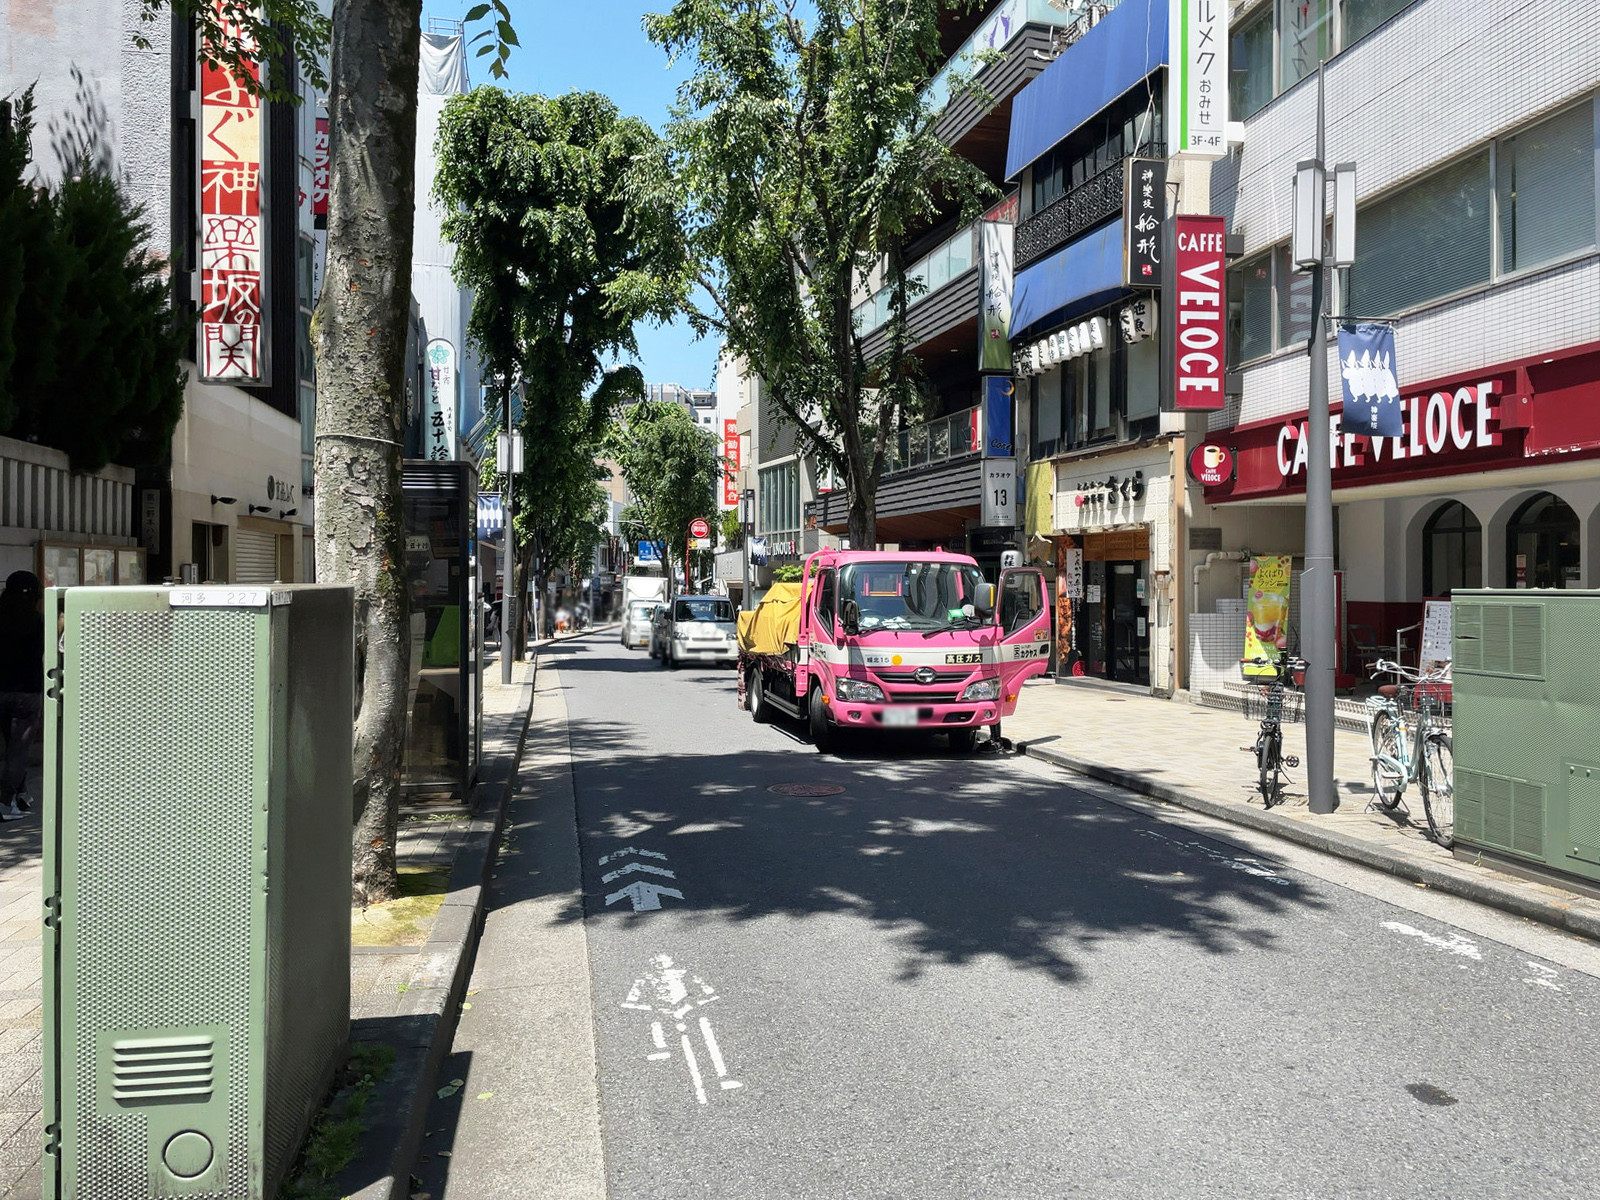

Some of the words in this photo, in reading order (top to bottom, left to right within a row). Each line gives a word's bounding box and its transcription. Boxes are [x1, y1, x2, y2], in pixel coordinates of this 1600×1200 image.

[1199, 79, 1212, 125] おみせ
[1180, 260, 1220, 392] VELOCE
[1200, 473, 1221, 482] VELOCE
[1105, 470, 1145, 504] さくら
[993, 489, 1007, 506] 13
[227, 592, 258, 604] 227
[946, 654, 982, 664] 高圧ガス
[1020, 648, 1038, 659] カクヤス
